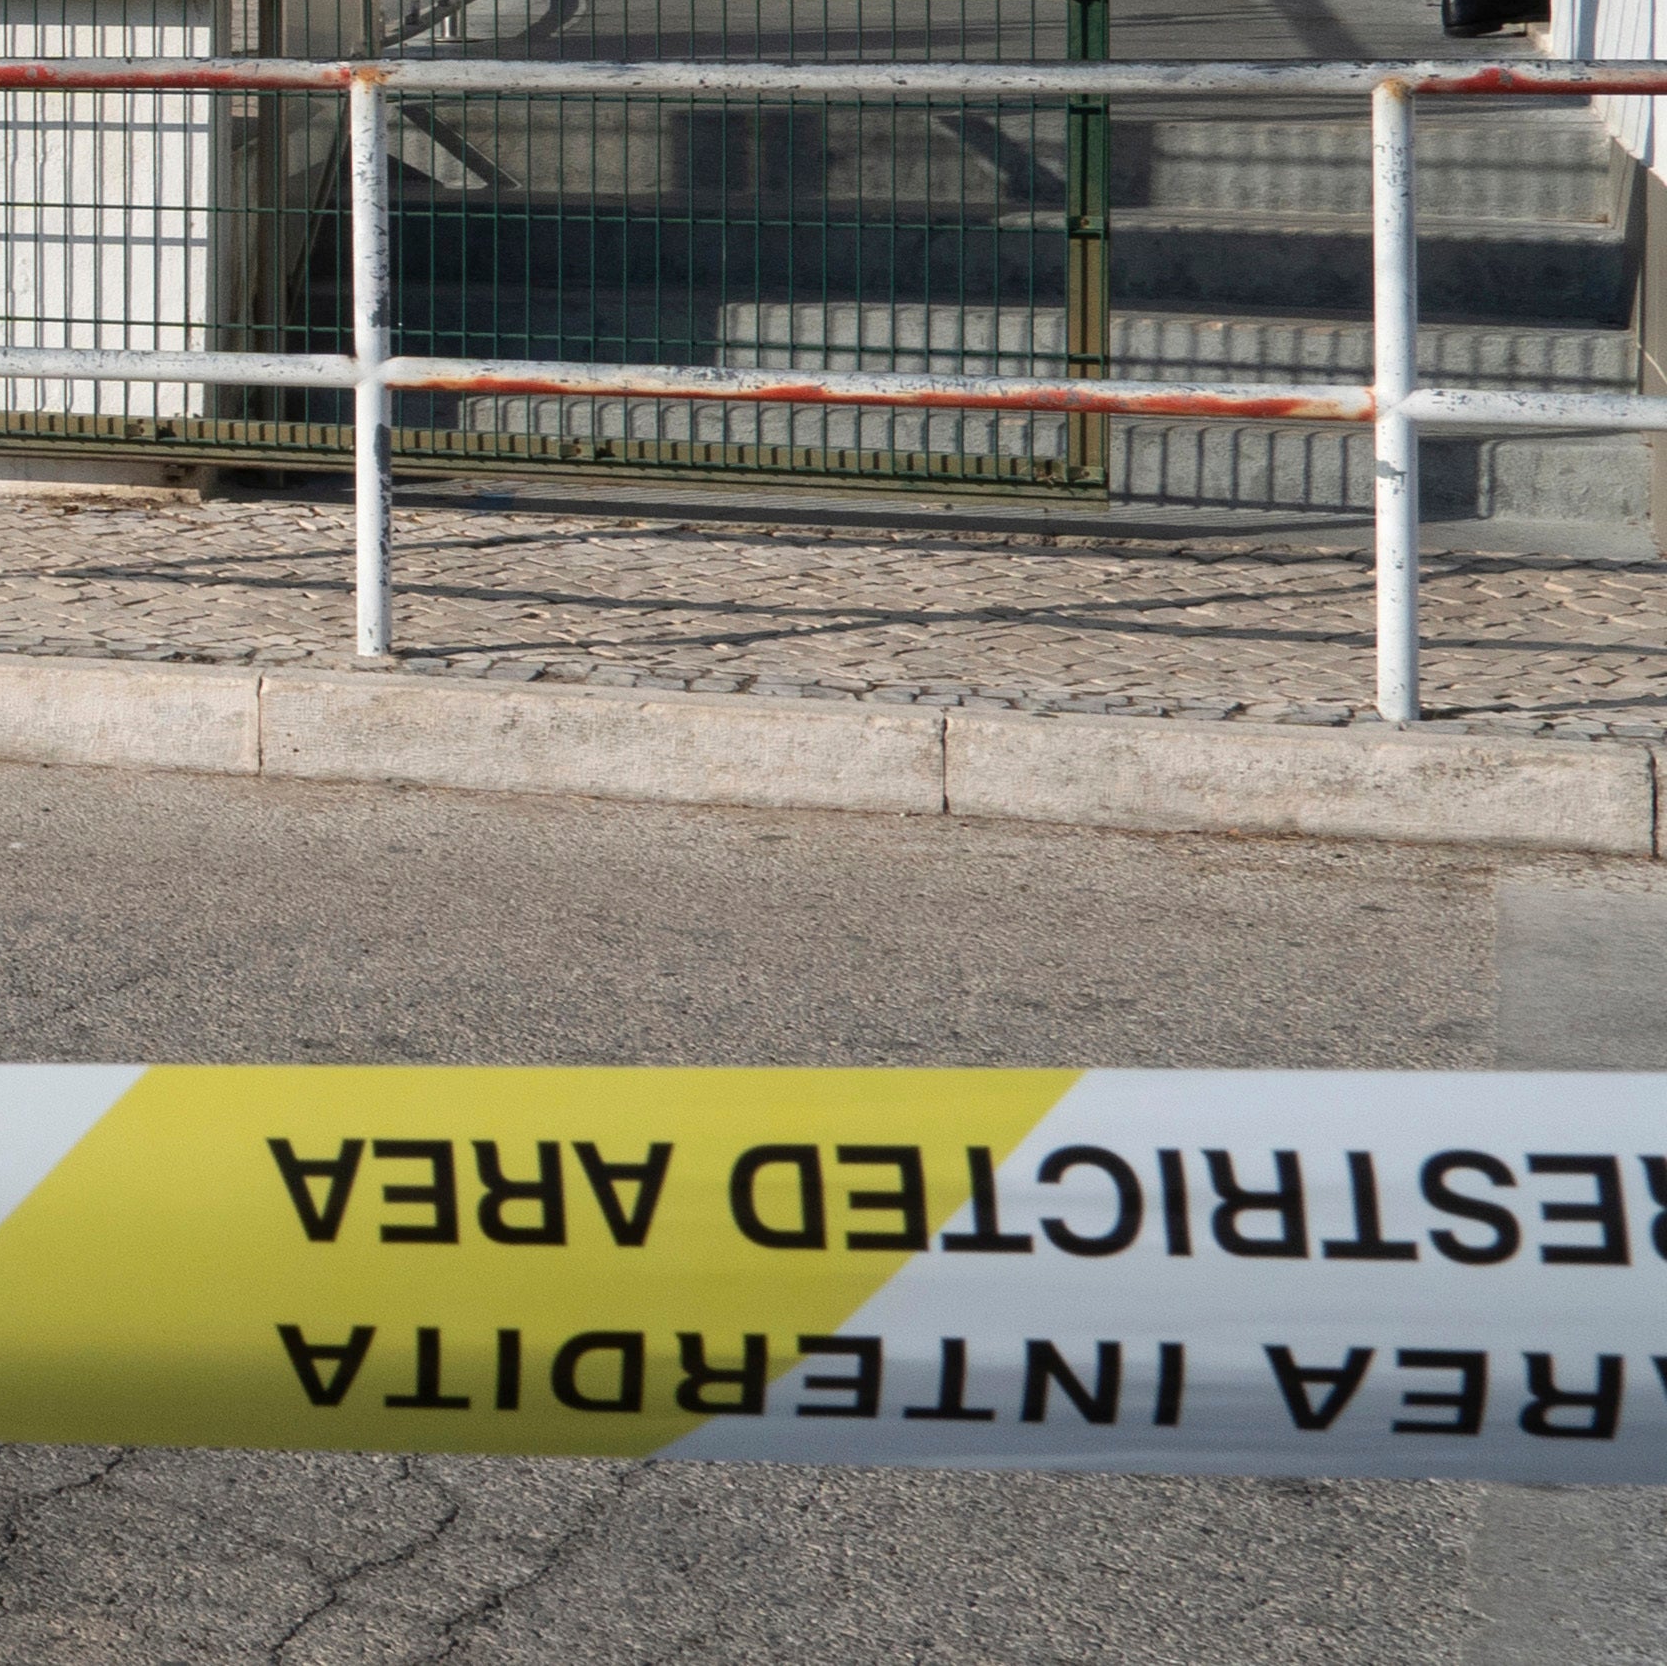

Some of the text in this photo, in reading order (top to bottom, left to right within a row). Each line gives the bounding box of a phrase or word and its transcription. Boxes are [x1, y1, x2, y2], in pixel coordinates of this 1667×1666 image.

[266, 1137, 674, 1249] AREA
[275, 1322, 1667, 1444] REA INTERDITA
